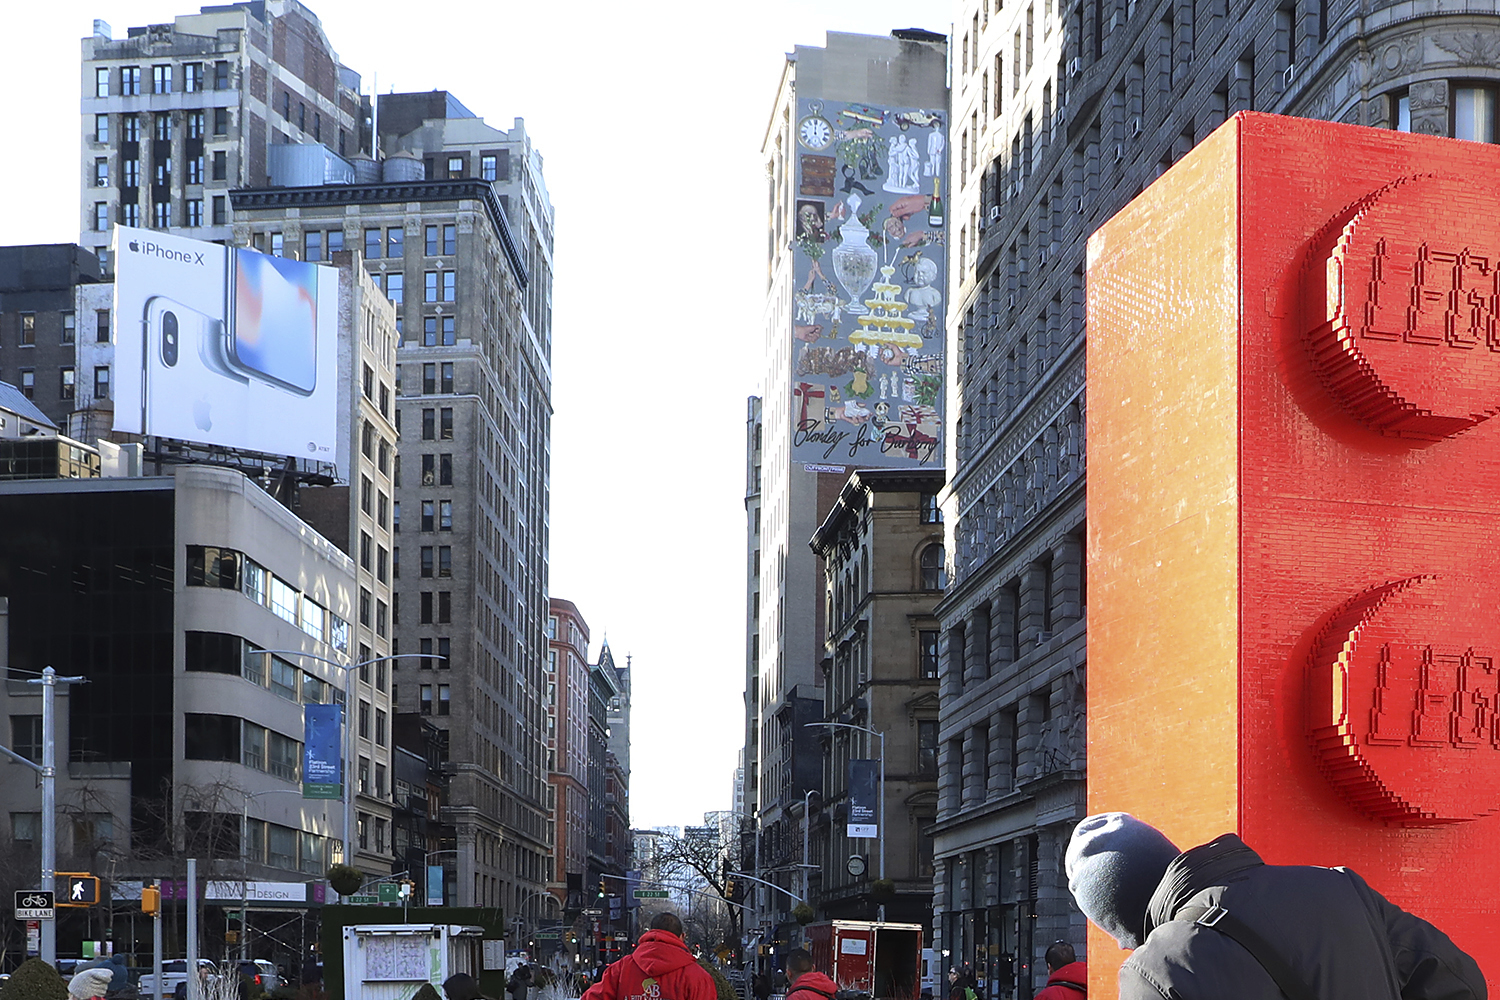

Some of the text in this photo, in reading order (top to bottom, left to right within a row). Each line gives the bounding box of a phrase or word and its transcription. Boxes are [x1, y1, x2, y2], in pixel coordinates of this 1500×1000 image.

[142, 241, 204, 266] iPhone X
[849, 423, 876, 457] for
[257, 890, 289, 899] DESIGN
